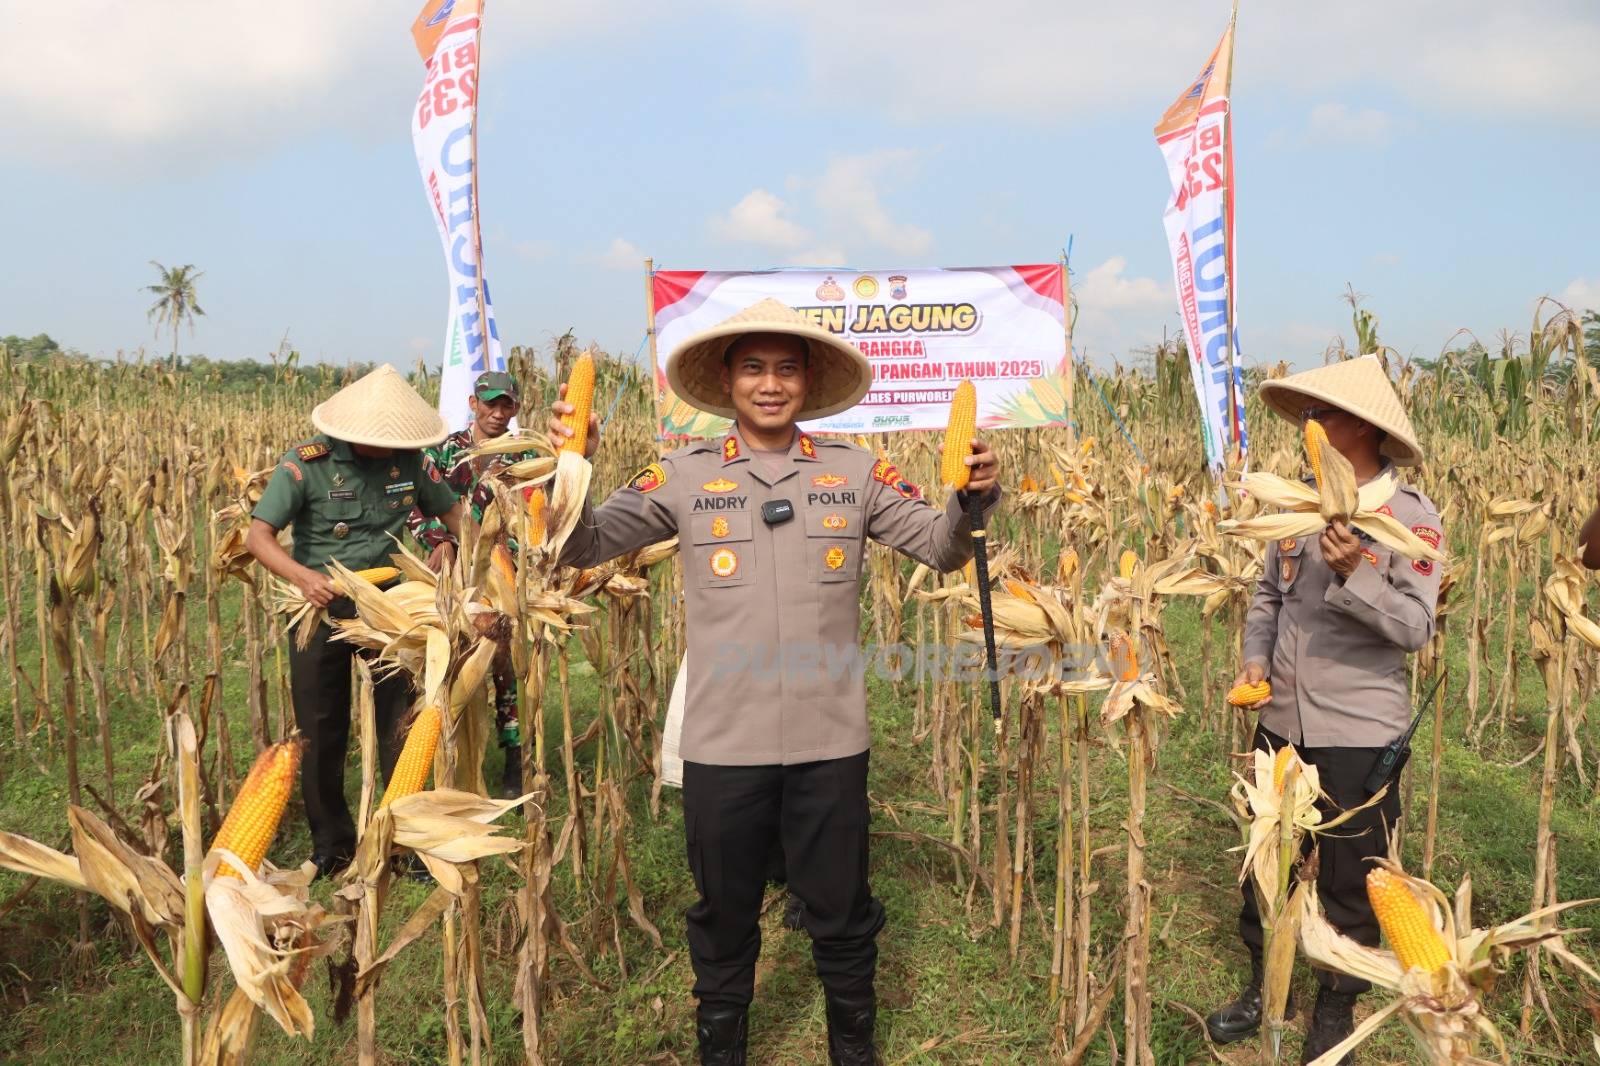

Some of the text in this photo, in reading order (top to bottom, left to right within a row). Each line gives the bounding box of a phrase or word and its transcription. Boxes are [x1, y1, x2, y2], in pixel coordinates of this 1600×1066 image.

[850, 303, 977, 333] JAGUNG
[859, 341, 923, 357] RANGKA
[880, 363, 942, 379] PANGAN
[945, 361, 996, 378] TAHUN
[1000, 360, 1041, 376] 2025
[693, 496, 748, 511] ANDRY
[807, 491, 857, 506] POLRI
